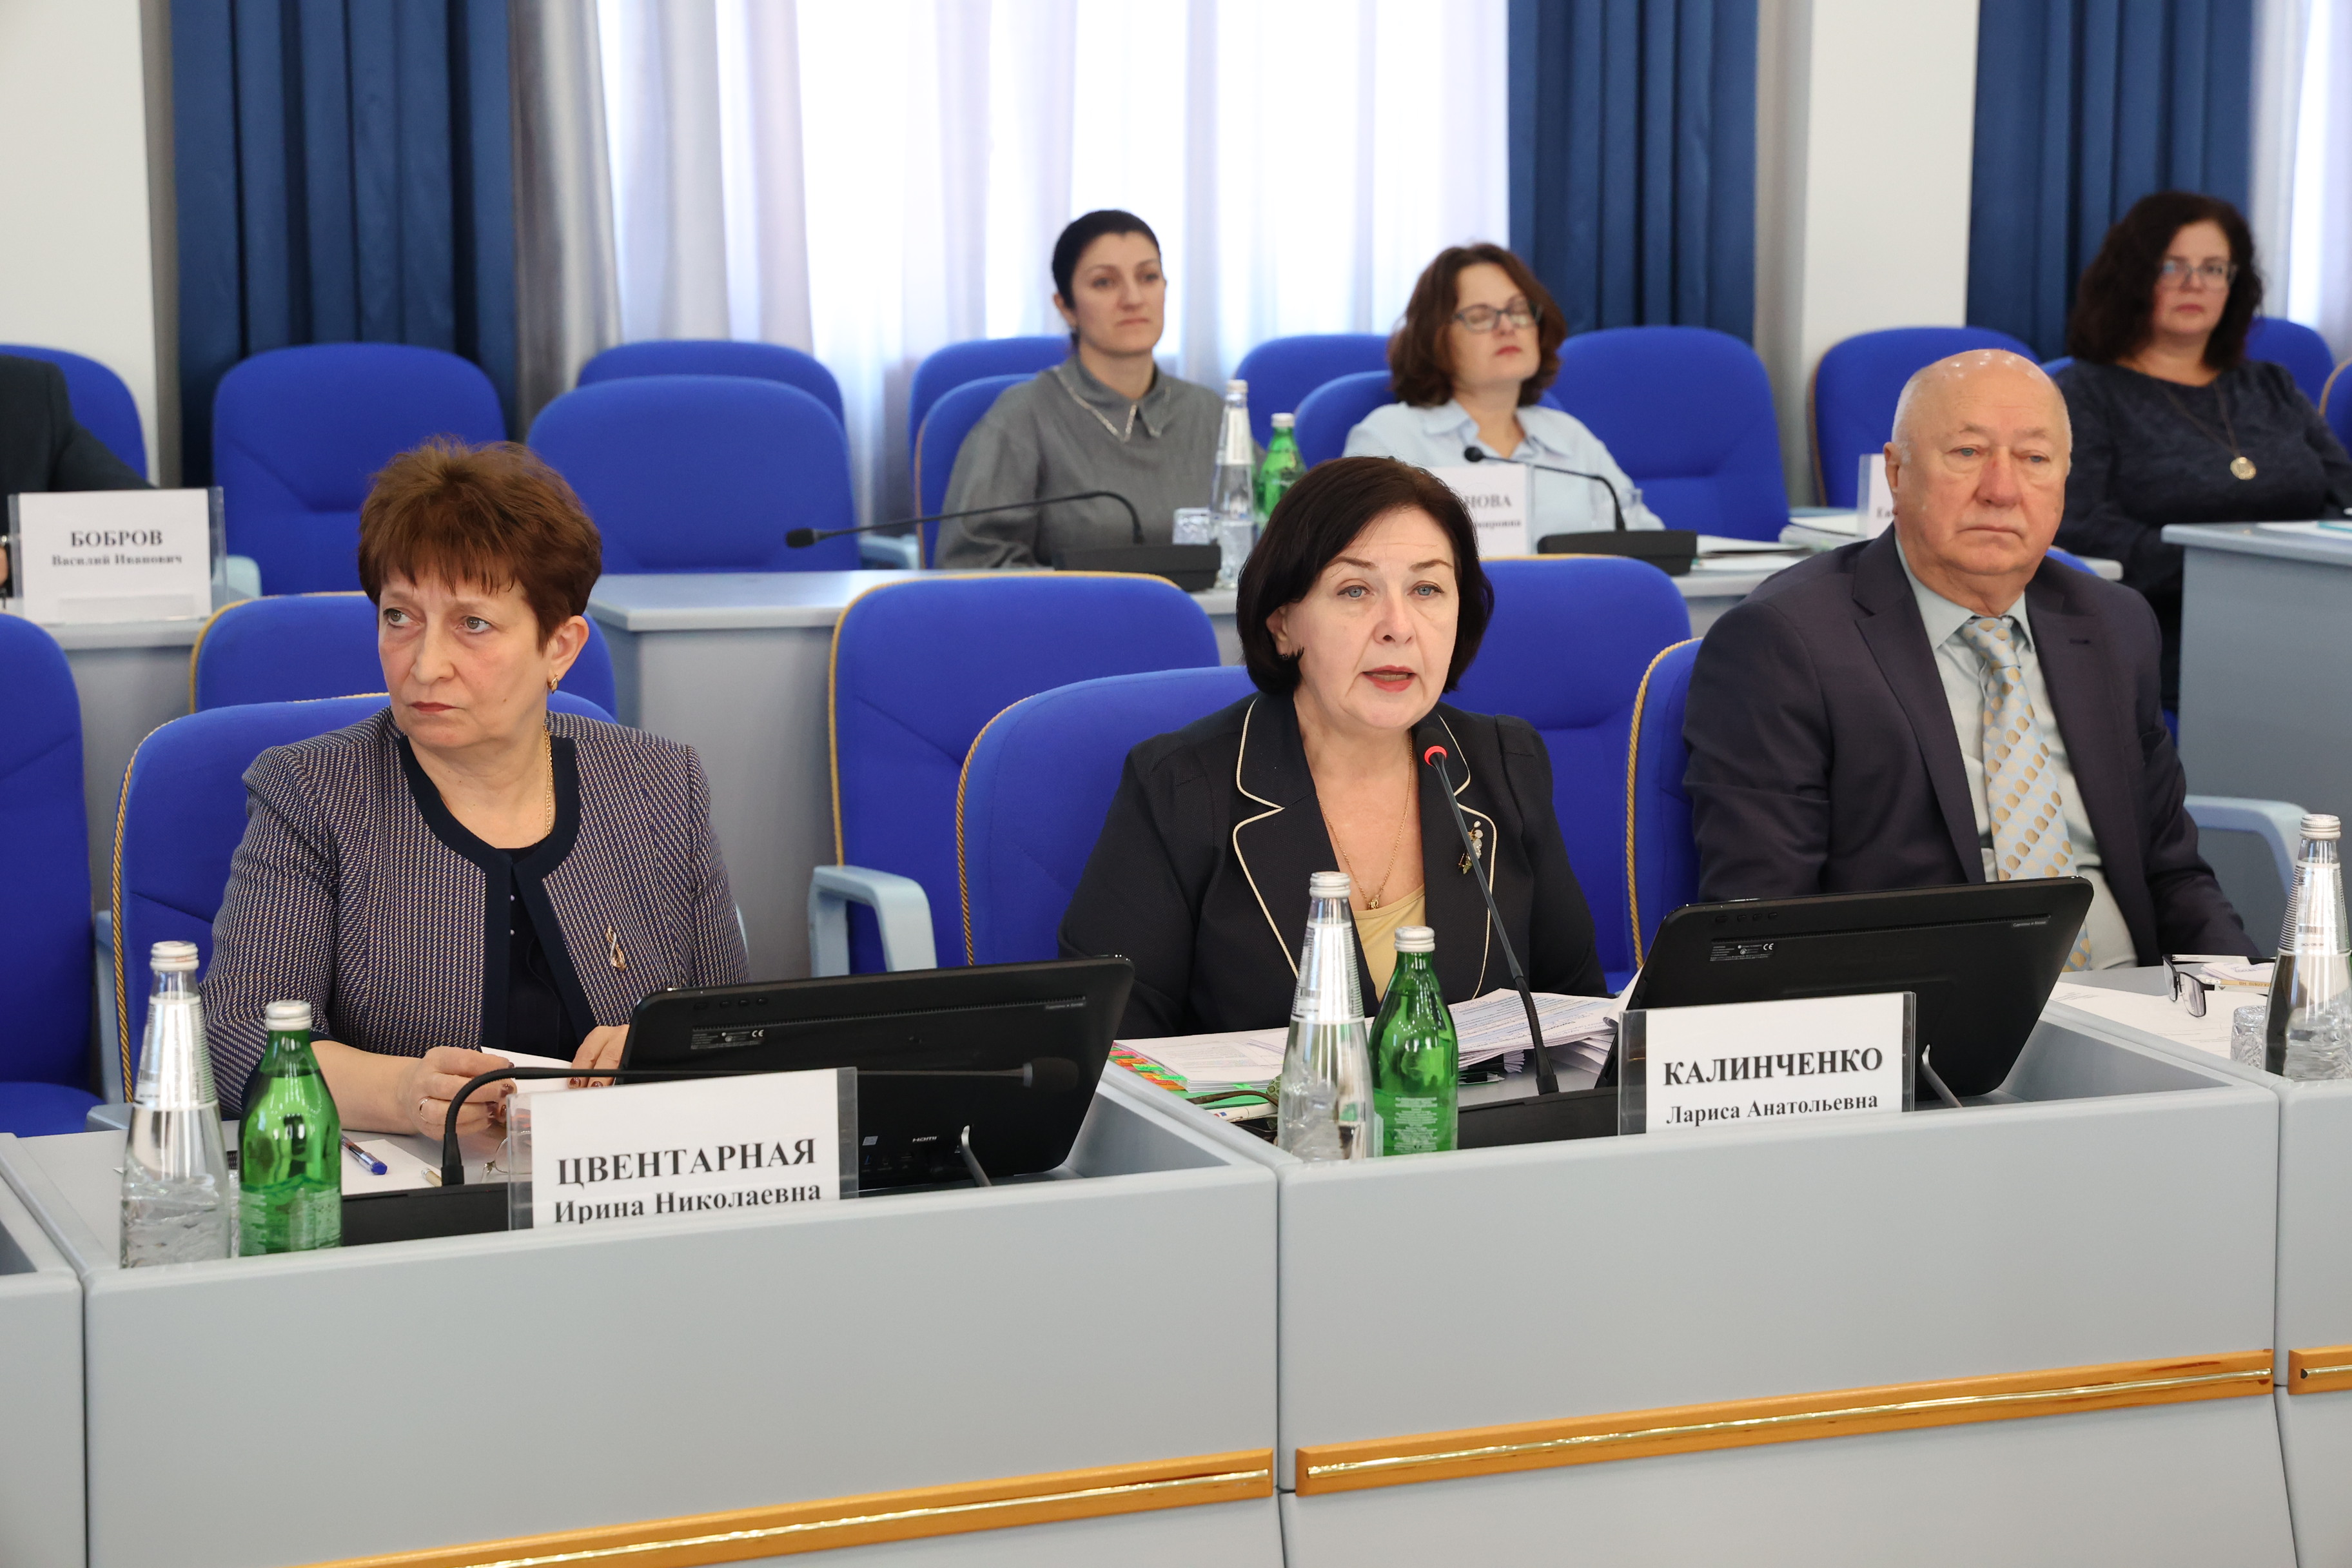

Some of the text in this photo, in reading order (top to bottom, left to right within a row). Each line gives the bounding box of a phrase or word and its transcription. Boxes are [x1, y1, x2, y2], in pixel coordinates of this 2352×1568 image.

[1464, 495, 1511, 507] НОВА
[71, 529, 163, 547] БОБРОВ
[52, 554, 182, 567] Василий Иванович
[1663, 1046, 1883, 1086] КАЛИНЧЕНКО
[1666, 1095, 1878, 1127] Лариса Анатольевна
[558, 1138, 818, 1190] ЦВЕНТАРНАЯ
[554, 1184, 821, 1224] Ирина Николаевна
